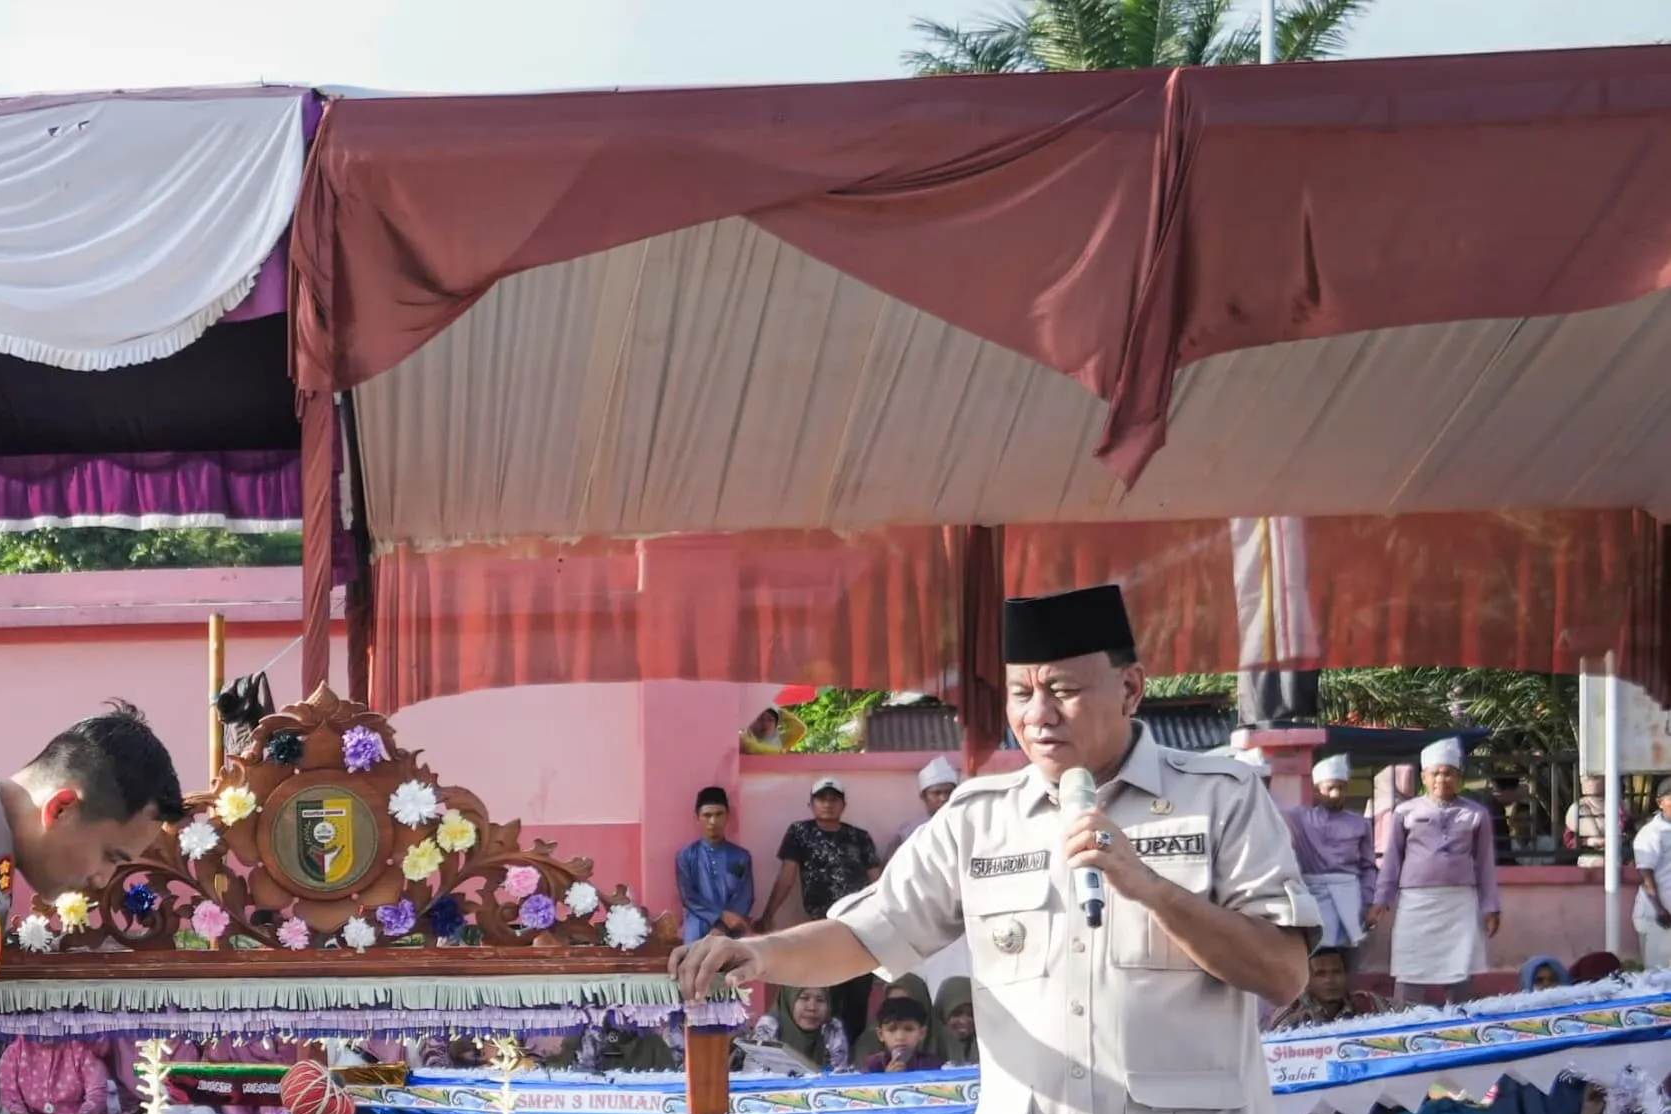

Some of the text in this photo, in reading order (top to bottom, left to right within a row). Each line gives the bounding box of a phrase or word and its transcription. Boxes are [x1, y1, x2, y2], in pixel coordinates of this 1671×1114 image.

[1135, 837, 1201, 855] UPATI
[517, 1093, 661, 1111] SMPN 3 INUMAN
